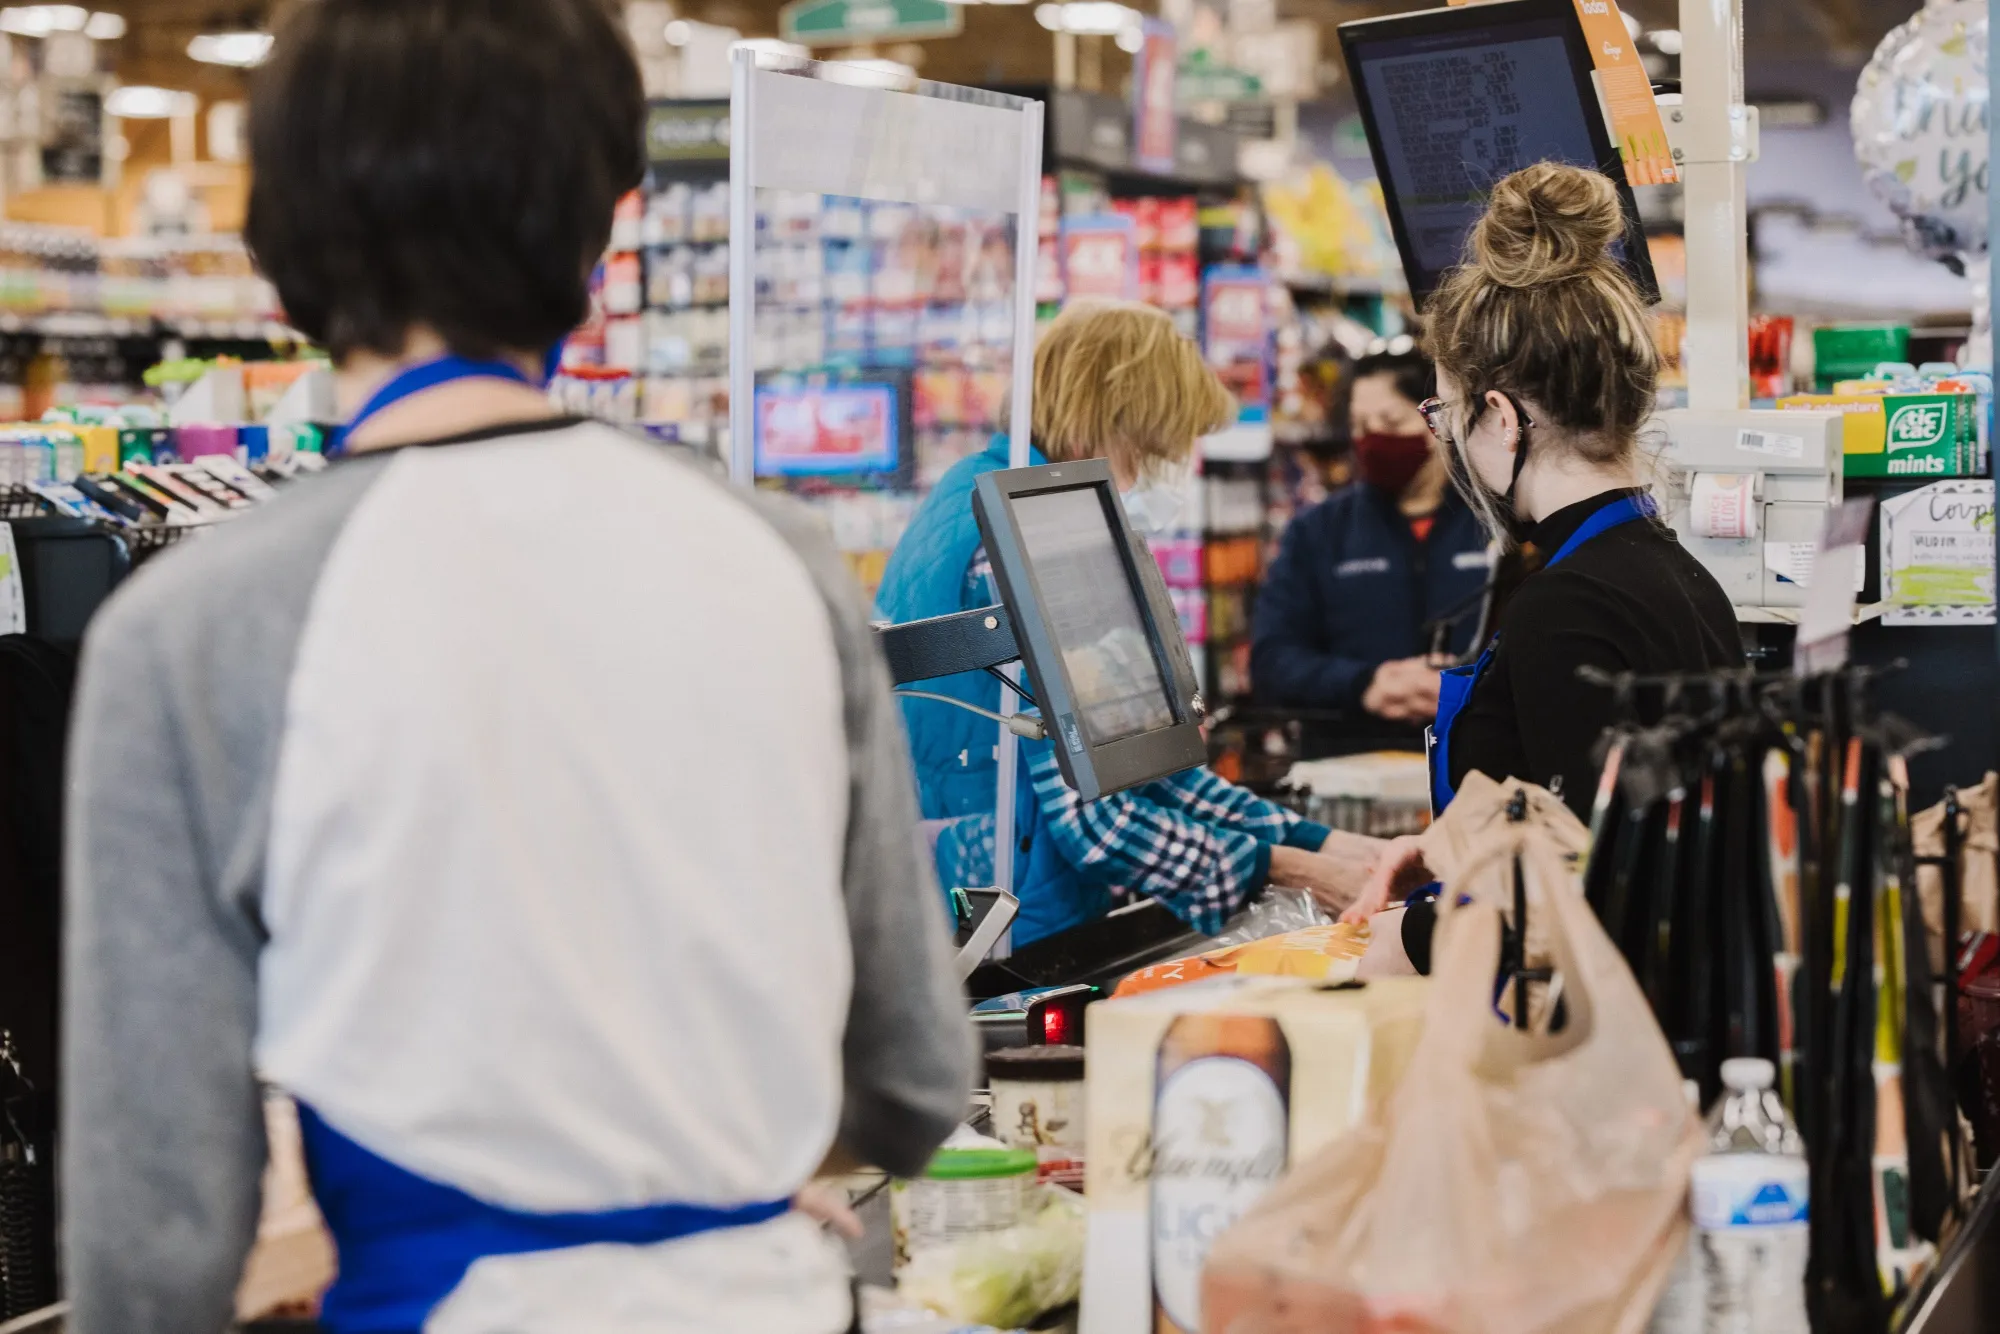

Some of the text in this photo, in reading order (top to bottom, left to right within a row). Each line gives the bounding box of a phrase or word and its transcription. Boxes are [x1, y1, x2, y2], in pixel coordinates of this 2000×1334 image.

[1906, 408, 1941, 426] tic
[1898, 422, 1936, 439] tac
[1887, 453, 1945, 474] mints
